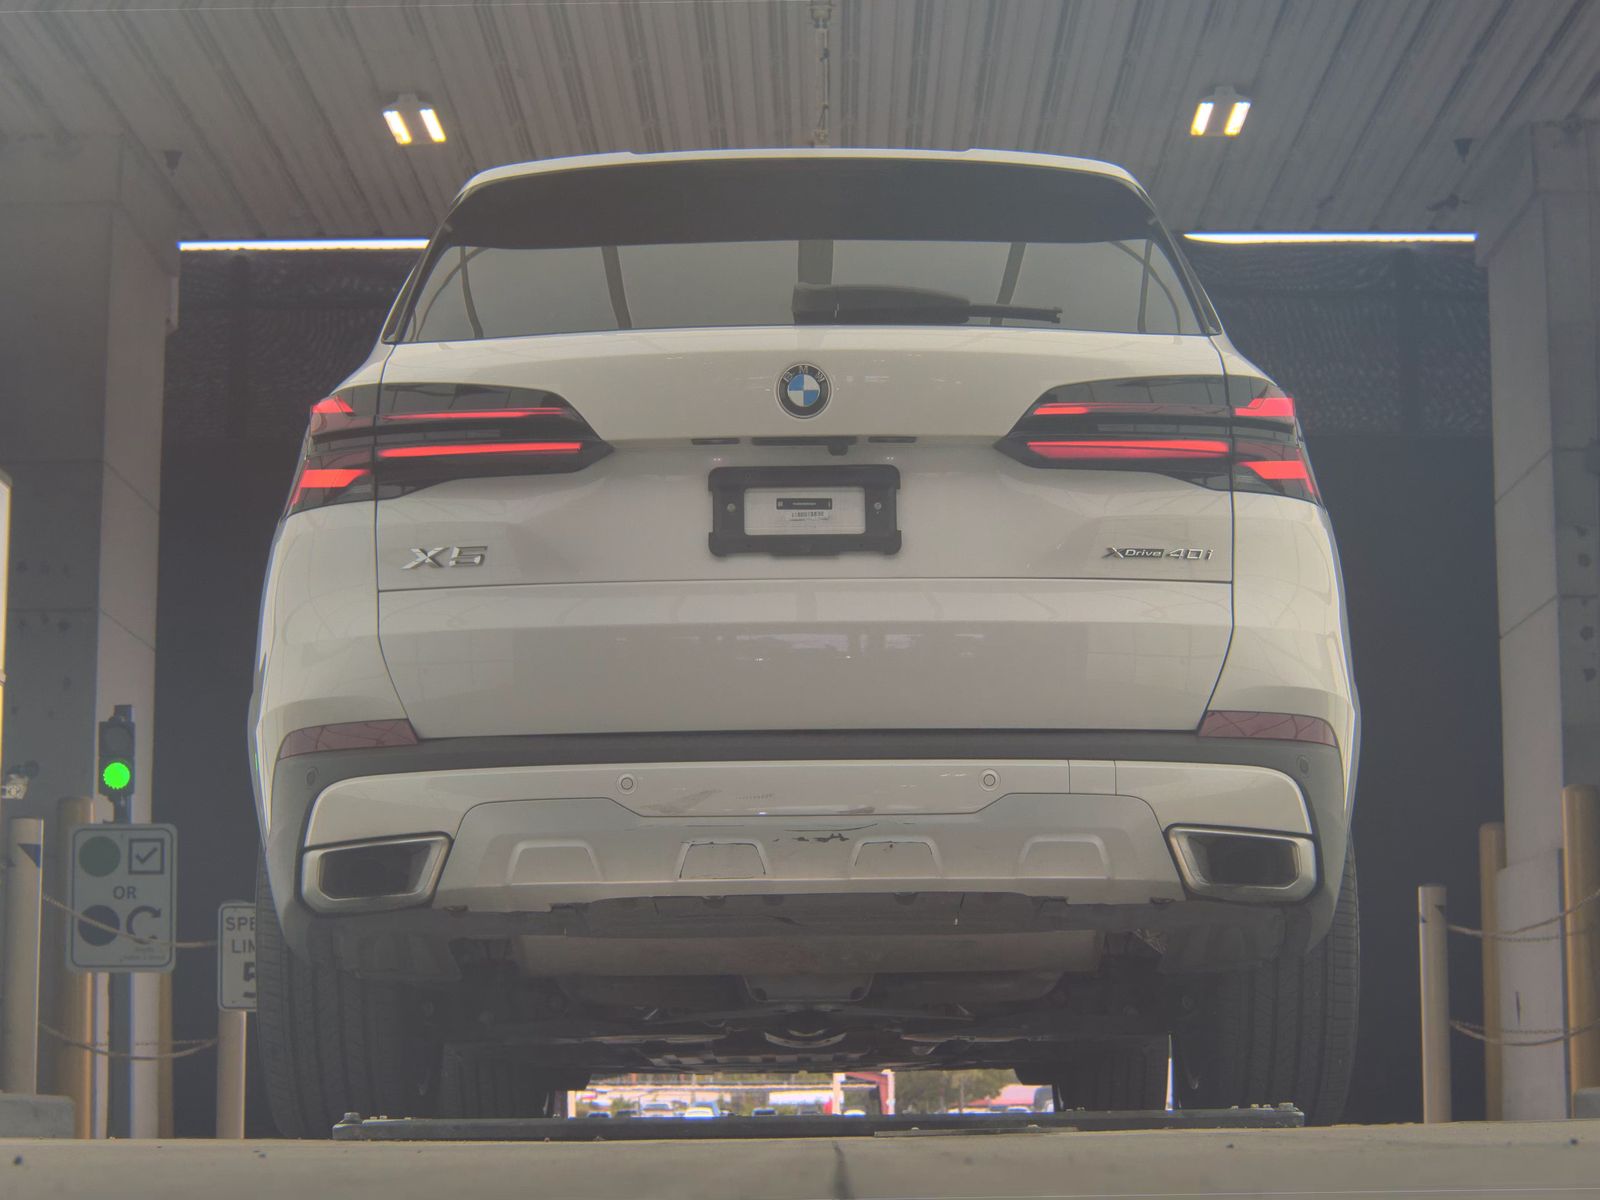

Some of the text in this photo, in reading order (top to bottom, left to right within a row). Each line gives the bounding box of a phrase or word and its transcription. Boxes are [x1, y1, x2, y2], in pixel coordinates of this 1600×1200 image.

[783, 364, 826, 382] BMW
[401, 546, 488, 569] X5
[113, 886, 137, 900] OR
